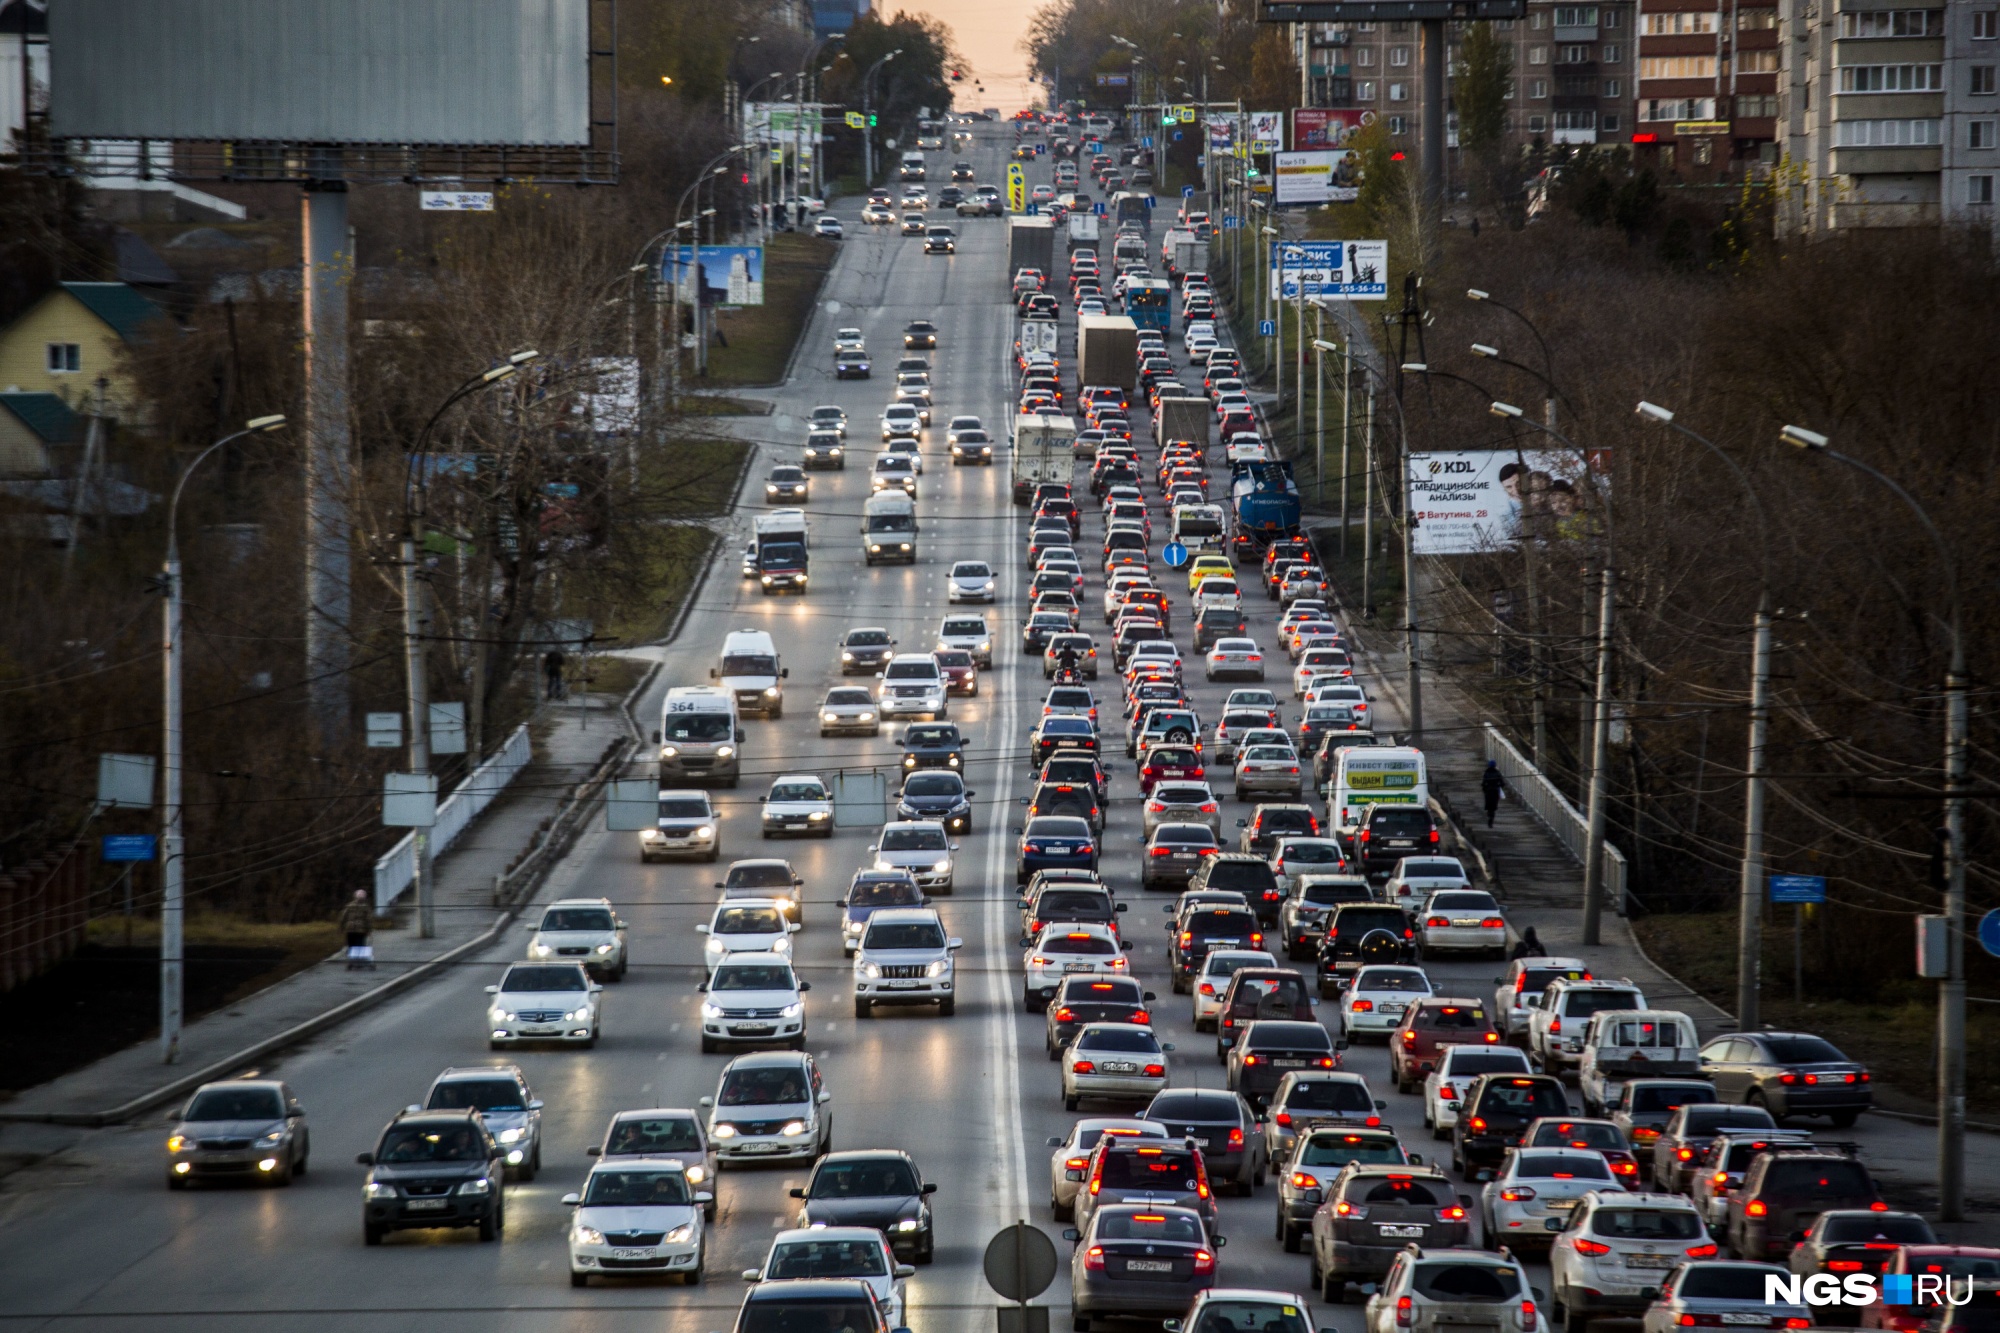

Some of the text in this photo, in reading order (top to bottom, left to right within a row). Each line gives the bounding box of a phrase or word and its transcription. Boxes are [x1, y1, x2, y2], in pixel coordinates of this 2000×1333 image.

[1284, 251, 1331, 261] СЕРВИС
[1444, 461, 1476, 473] KDL
[1415, 482, 1490, 492] МЕДИЦИНСКИЕ
[1428, 493, 1476, 501] АНАЛИЗЫ
[1427, 511, 1474, 519] Ватутина,
[670, 702, 694, 712] 364
[1352, 776, 1412, 786] ВЫДАЕМ ДЕНЬГИ
